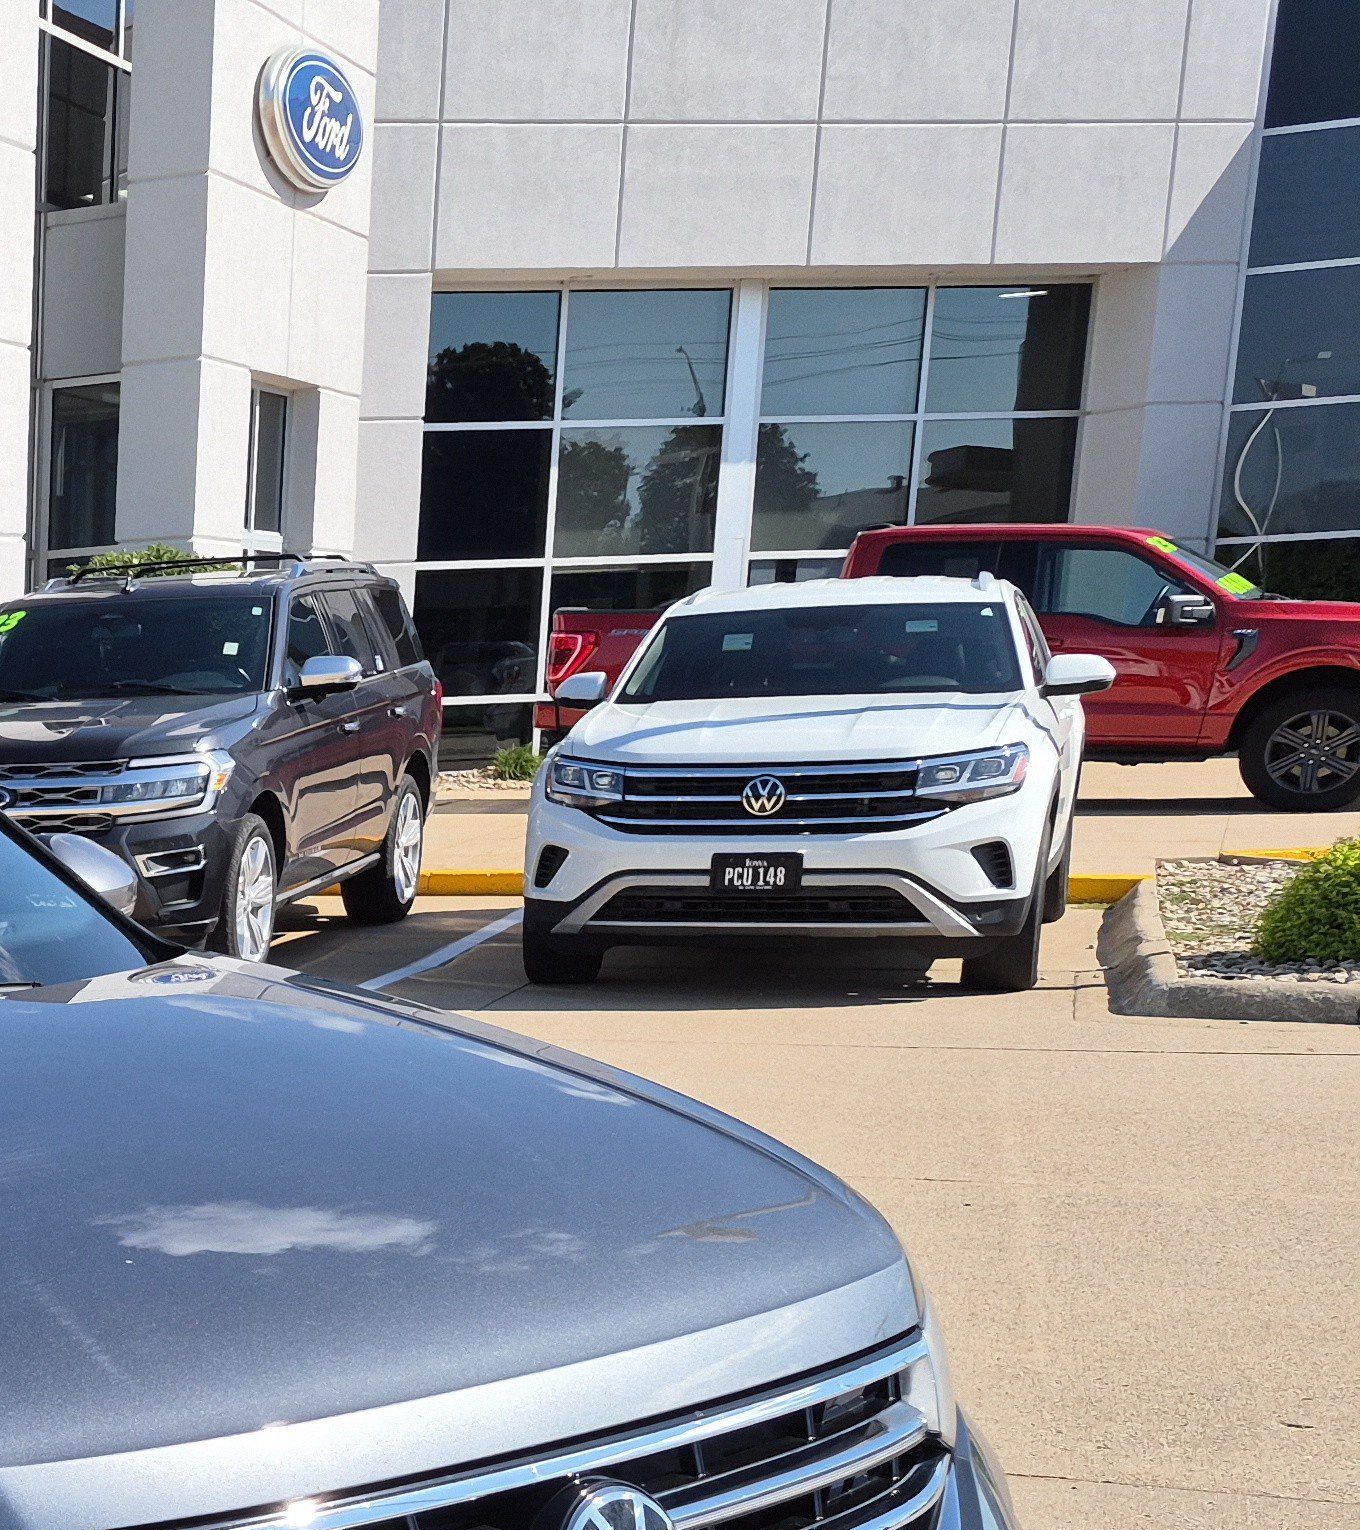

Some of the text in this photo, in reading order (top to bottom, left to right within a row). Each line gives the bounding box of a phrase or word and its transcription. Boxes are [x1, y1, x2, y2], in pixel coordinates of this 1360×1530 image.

[302, 75, 353, 161] Ford
[724, 866, 786, 886] PCU 148
